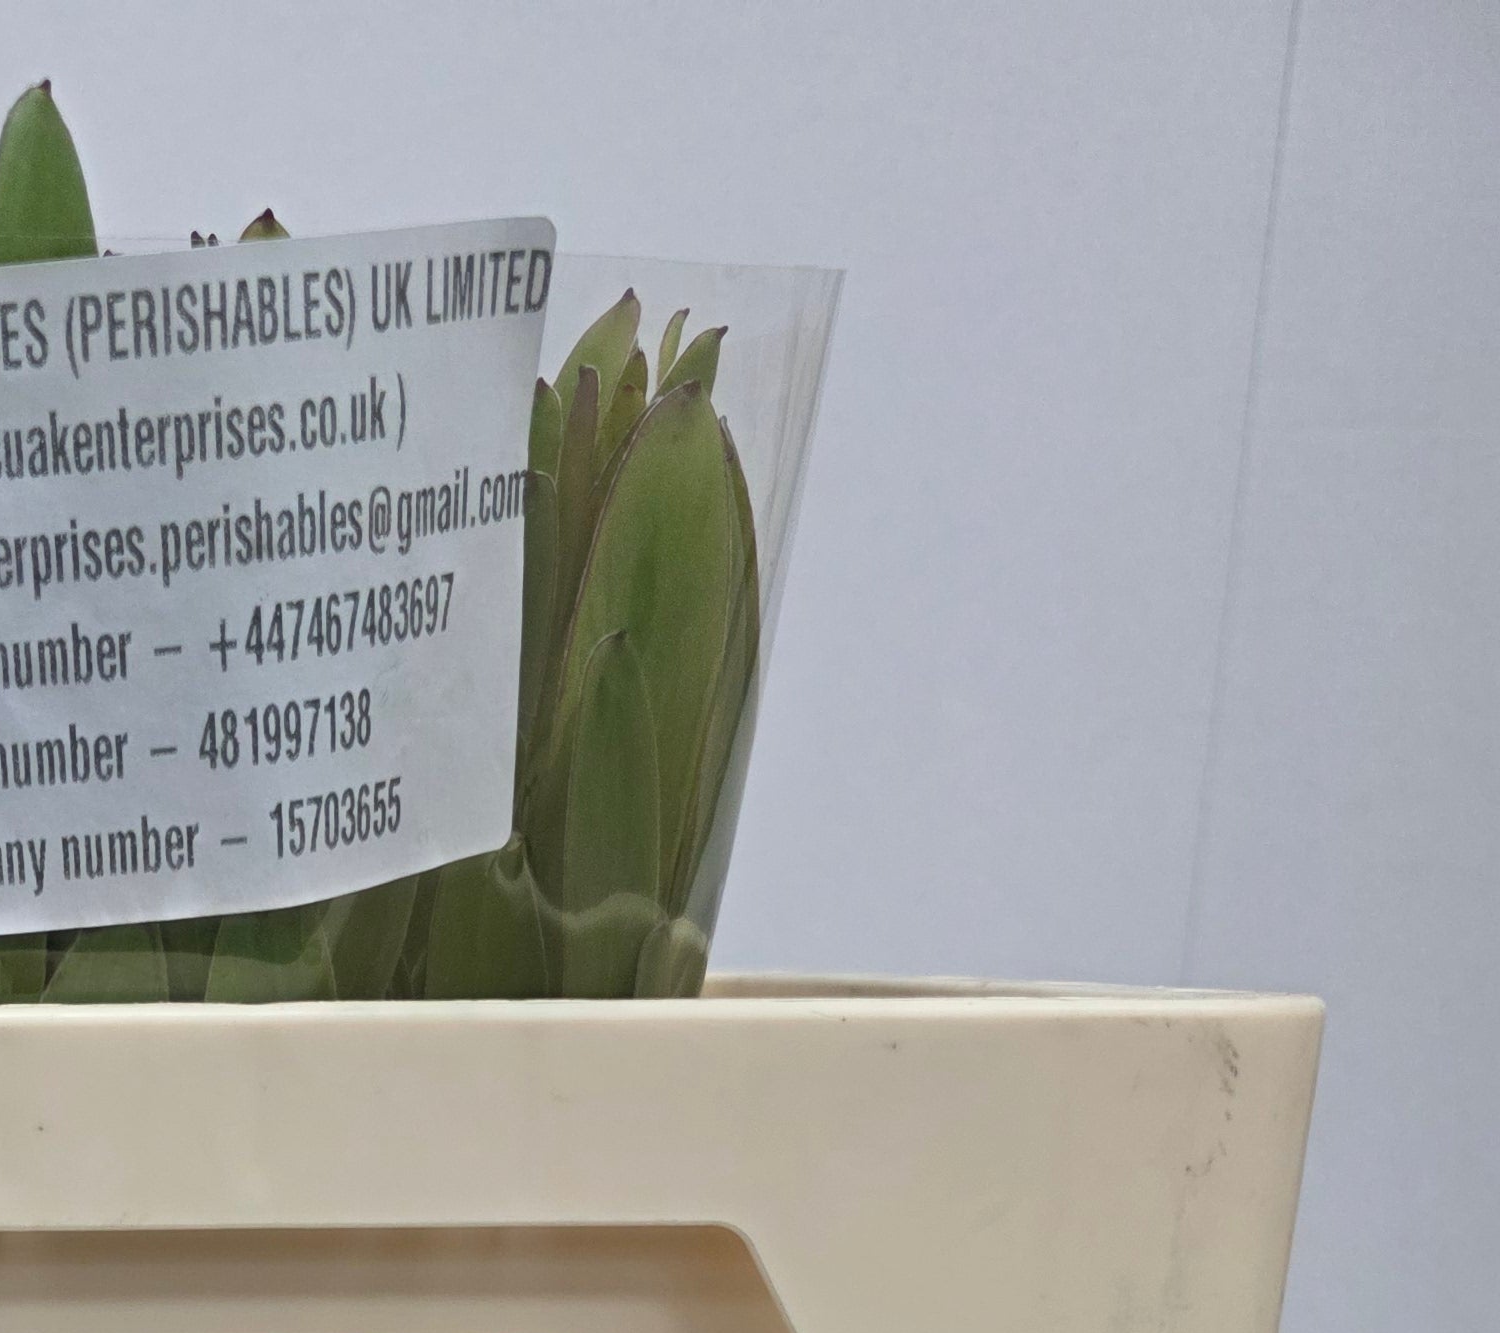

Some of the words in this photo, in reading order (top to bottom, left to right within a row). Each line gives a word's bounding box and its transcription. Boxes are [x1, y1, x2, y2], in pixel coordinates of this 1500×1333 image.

[65, 267, 356, 380] (PERISHABLES)
[371, 261, 413, 333] UK
[426, 247, 553, 325] LIMITED
[198, 687, 372, 770] 481997138
[61, 814, 200, 880] number
[269, 775, 402, 860] 15703655
